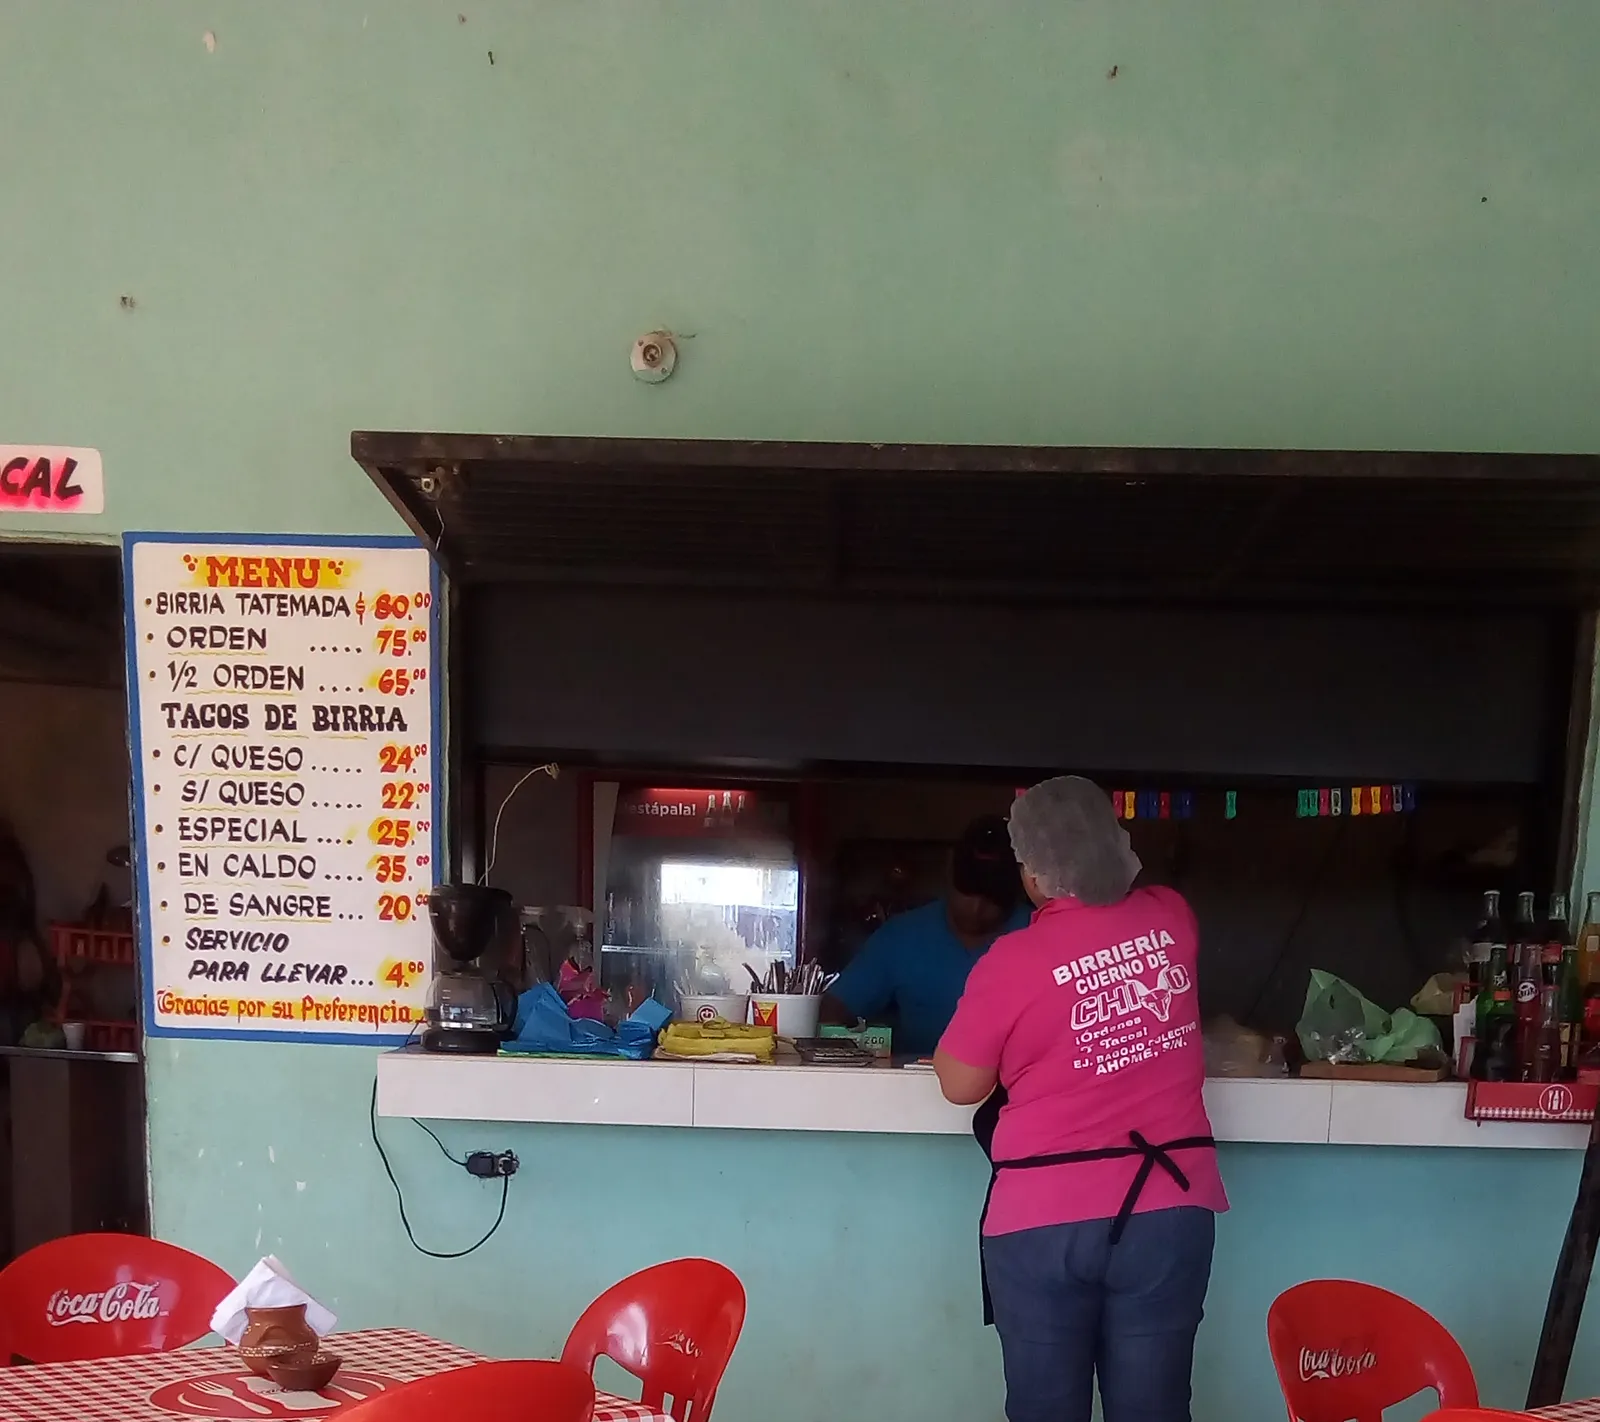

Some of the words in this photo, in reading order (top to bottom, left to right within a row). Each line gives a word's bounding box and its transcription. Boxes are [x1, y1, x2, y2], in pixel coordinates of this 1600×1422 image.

[206, 556, 321, 588] MENU
[155, 591, 226, 615] BIRRIA
[235, 592, 351, 617] TATEMADA
[167, 625, 267, 650] ORDEN
[213, 663, 304, 690] ORDEN
[161, 702, 249, 730] TACOS
[264, 704, 298, 731] DE
[312, 705, 408, 732] BIRRIA
[211, 744, 303, 771] QUESO
[218, 780, 305, 807] QUESO
[628, 801, 697, 817] estápala!
[178, 816, 307, 844] ESPECIAL
[178, 852, 209, 877] EN
[223, 853, 317, 880] CALDO
[184, 892, 219, 915] DE
[229, 892, 332, 918] SANGRE
[185, 926, 289, 953] SERVICIO
[1052, 928, 1176, 986] BIRRIERÍA
[188, 959, 250, 983] PARA
[260, 961, 348, 986] LLEVAR
[1075, 958, 1144, 995] CUERNO
[1146, 950, 1170, 970] DE
[156, 990, 229, 1017] Gracias
[237, 1000, 266, 1024] por
[271, 1001, 294, 1020] su
